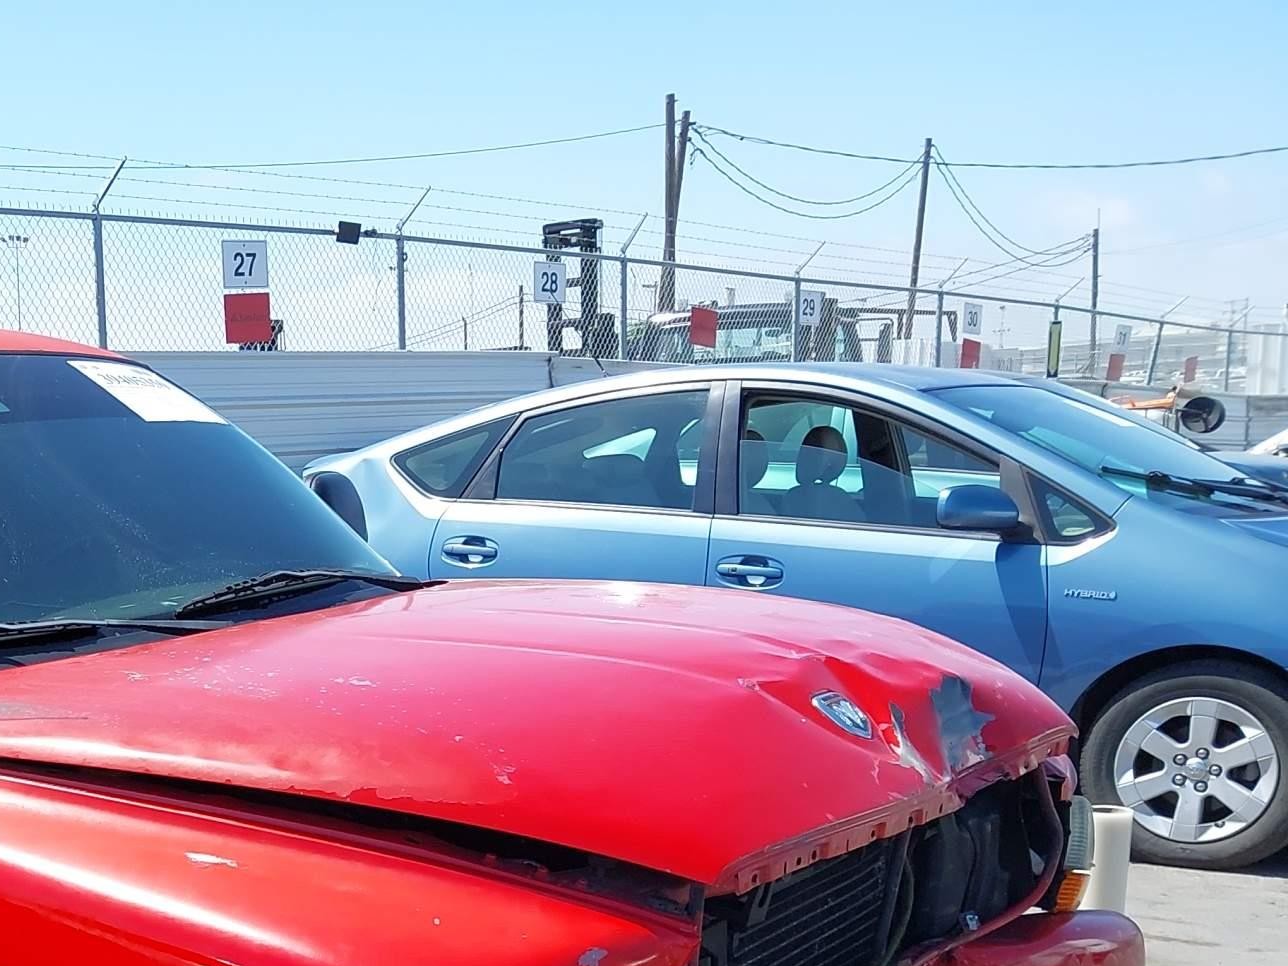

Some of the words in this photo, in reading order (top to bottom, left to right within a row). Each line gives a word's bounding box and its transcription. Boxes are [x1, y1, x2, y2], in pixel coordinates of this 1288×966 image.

[234, 252, 257, 277] 27
[541, 271, 558, 294] 28
[803, 298, 815, 317] 29
[967, 311, 978, 327] 30
[1064, 588, 1109, 599] HYBRID
